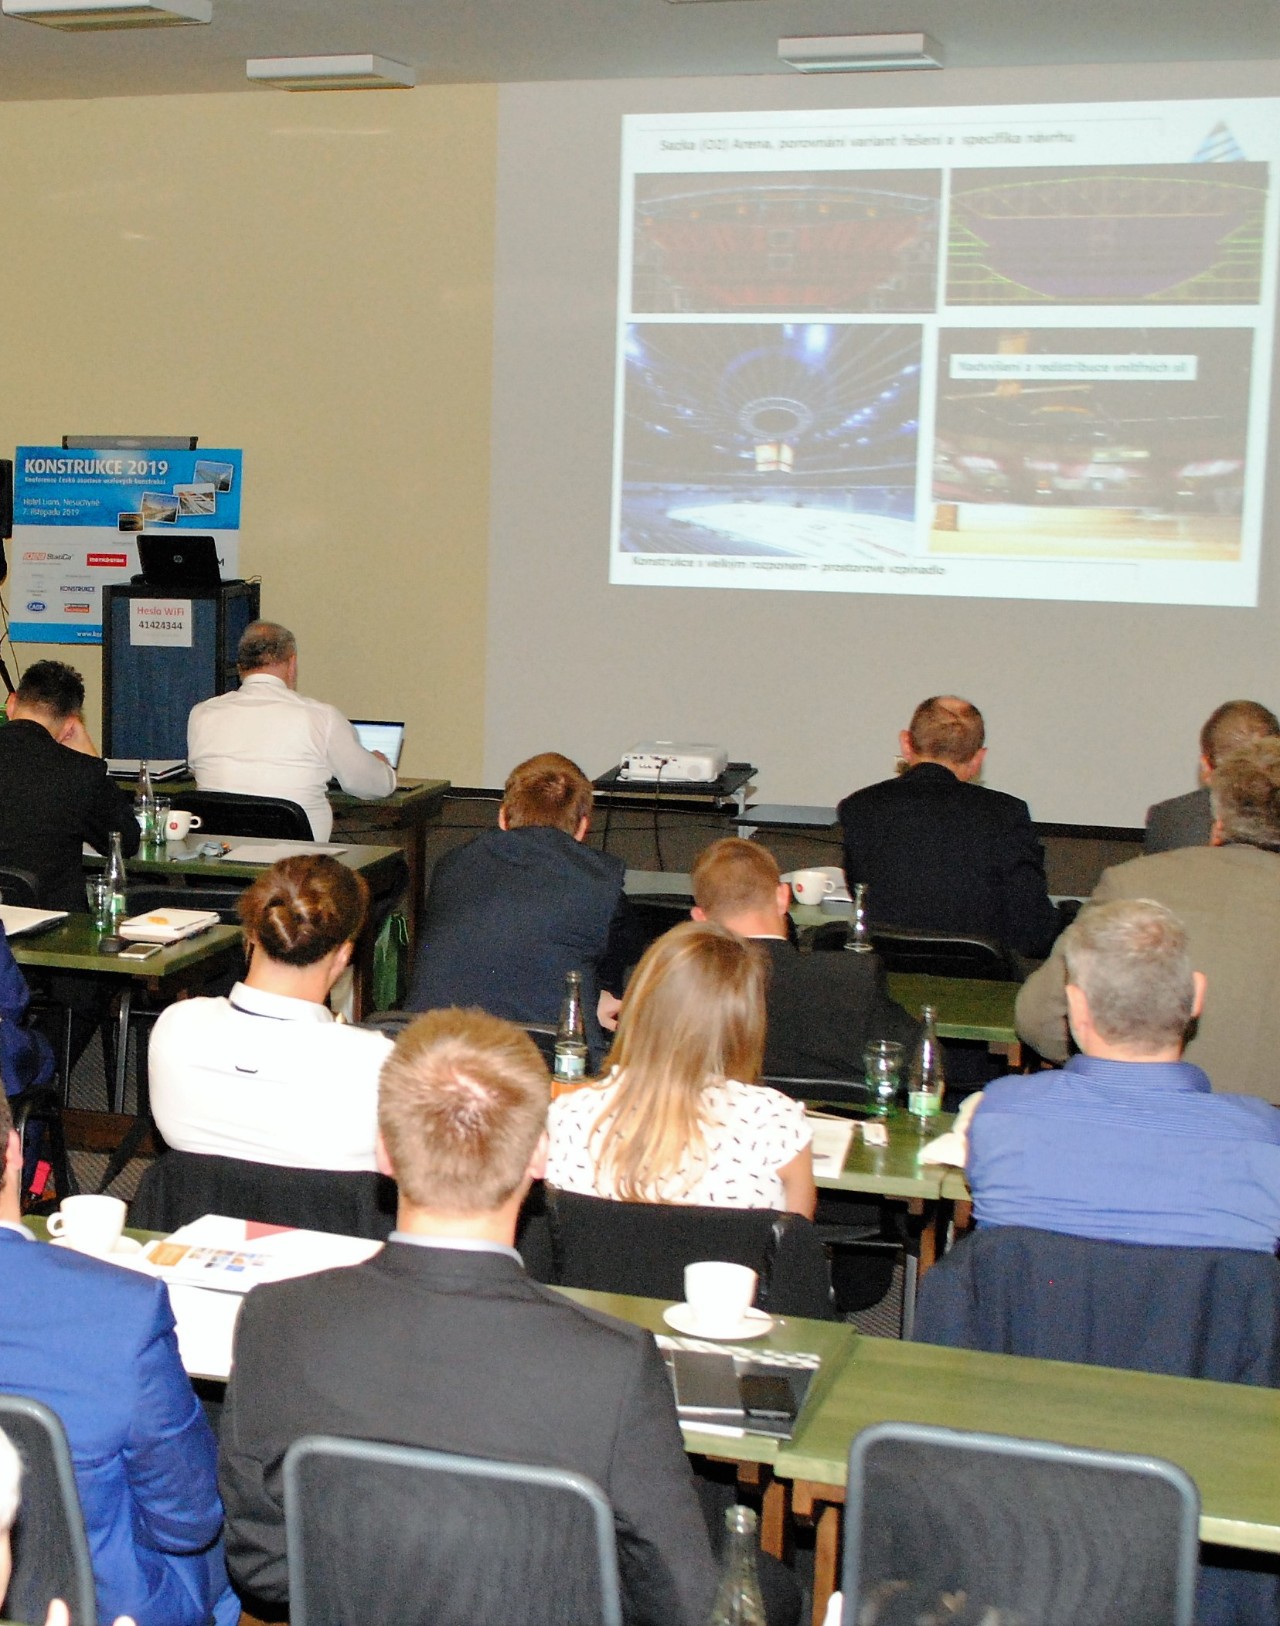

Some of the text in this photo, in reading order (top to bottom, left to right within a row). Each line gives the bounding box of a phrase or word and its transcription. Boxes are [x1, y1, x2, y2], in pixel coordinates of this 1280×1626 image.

[24, 458, 168, 476] KONSTRUKCE 2019
[62, 508, 80, 517] 2019
[136, 606, 185, 616] Heslo WiFi
[138, 621, 183, 630] 41424344
